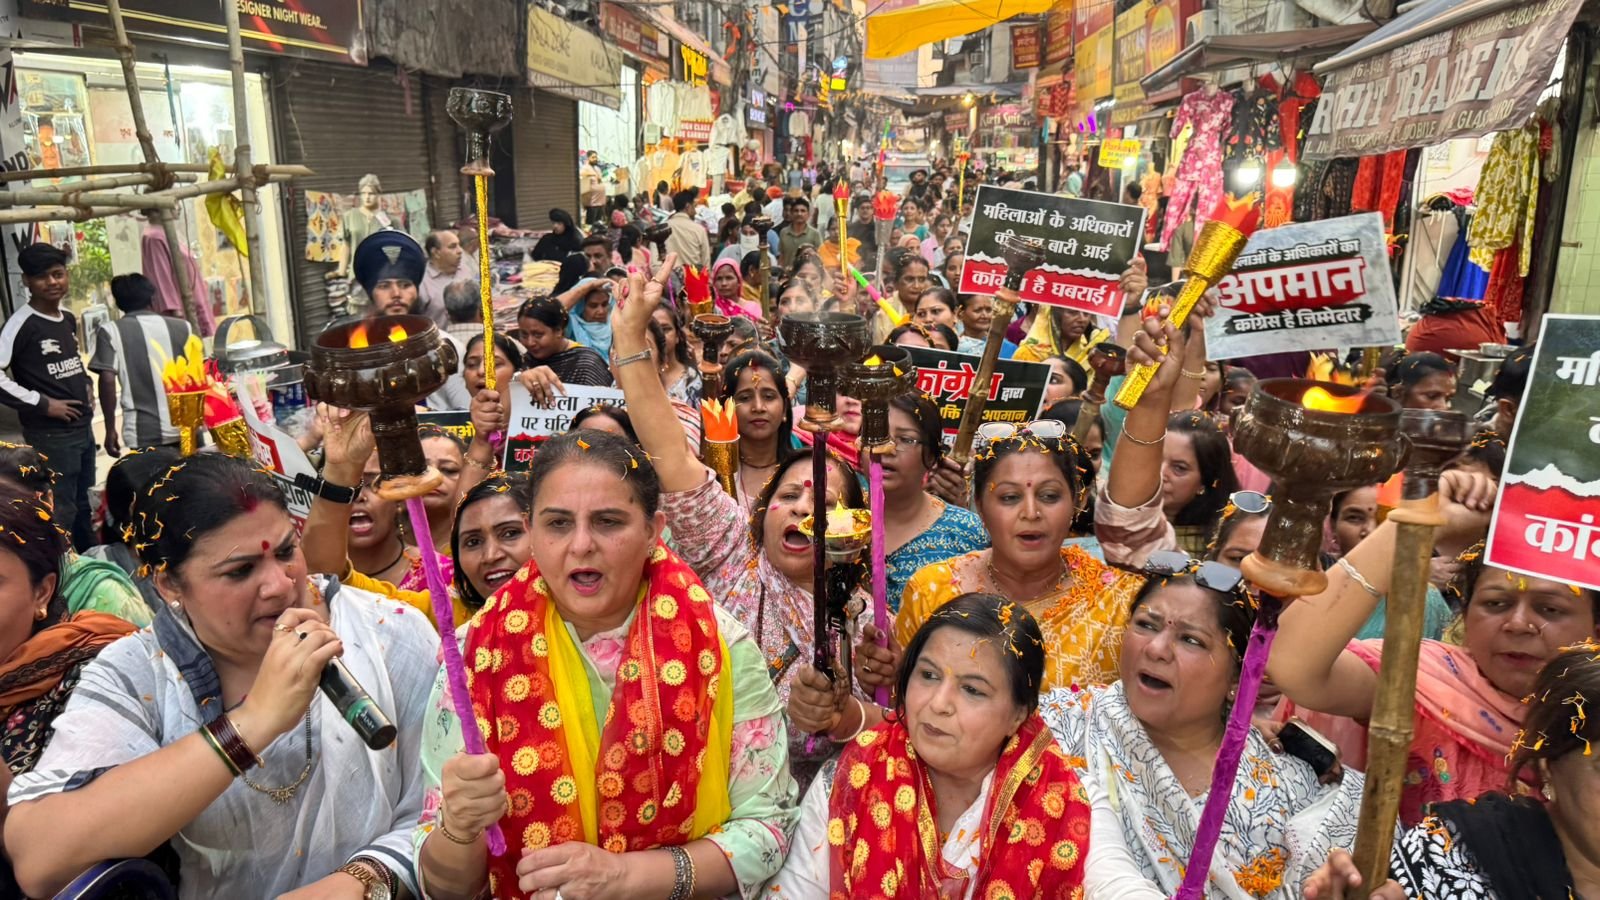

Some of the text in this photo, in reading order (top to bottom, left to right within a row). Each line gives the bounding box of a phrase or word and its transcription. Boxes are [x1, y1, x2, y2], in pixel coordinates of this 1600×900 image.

[236, 0, 272, 19] ESIGNER
[272, 6, 299, 24] NIGHT
[1393, 26, 1541, 122] TRADERS
[983, 202, 1135, 238] महिलाओं के अधिकारों
[1048, 238, 1078, 256] बारी
[1081, 243, 1112, 261] आई
[1268, 246, 1282, 262] के
[1283, 239, 1339, 260] अधिकारों
[1340, 239, 1360, 253] का
[1032, 274, 1048, 294] है
[1218, 257, 1366, 308] अपमान
[1233, 306, 1361, 333] कांग्रेस है जिम्मेदार
[47, 356, 81, 375] BURBE
[1001, 386, 1026, 402] द्वारा
[521, 414, 574, 432] पर घटि
[982, 409, 1028, 422] अपमान
